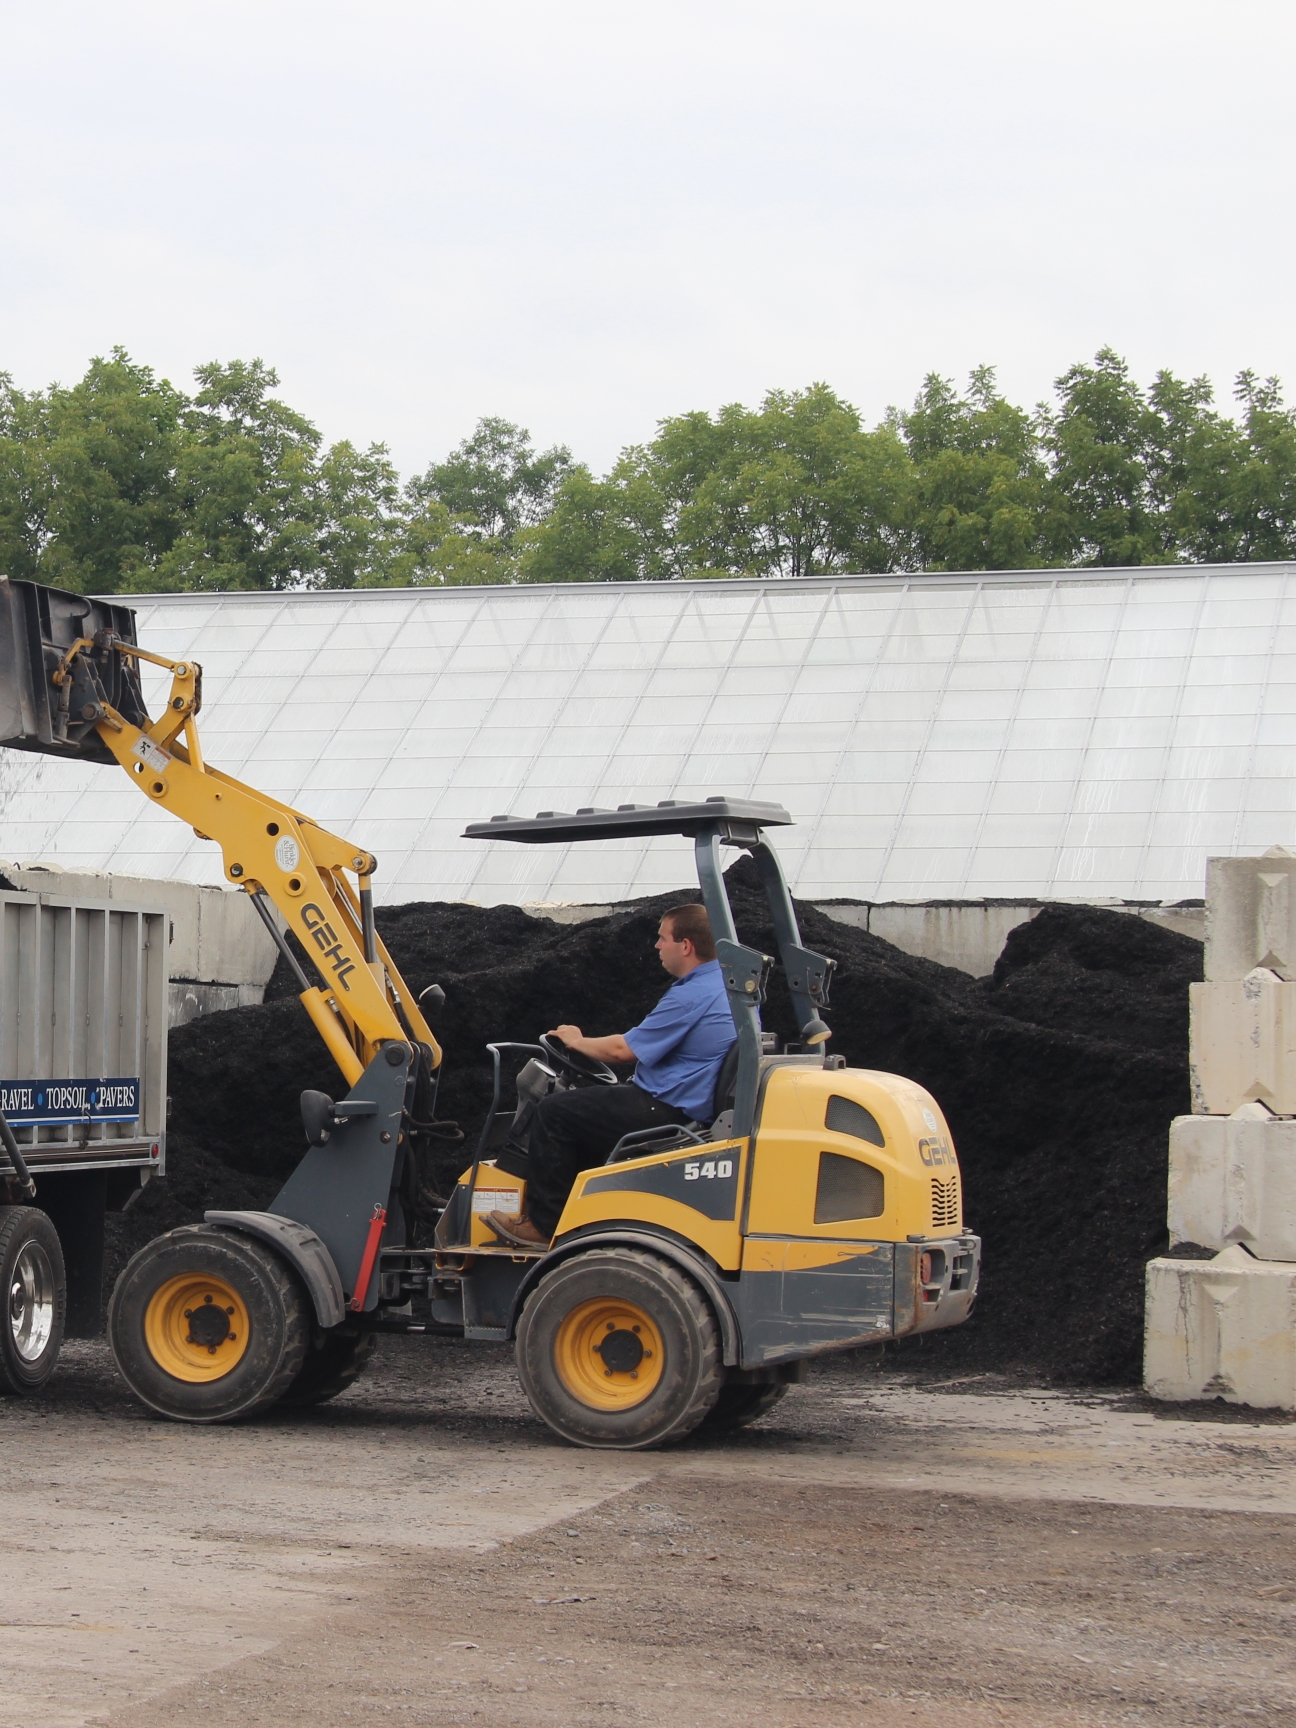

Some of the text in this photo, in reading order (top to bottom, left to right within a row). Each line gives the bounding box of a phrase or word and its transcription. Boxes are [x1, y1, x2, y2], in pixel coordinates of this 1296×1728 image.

[301, 903, 355, 991] GEHL
[46, 1087, 90, 1110] TOPSOIL
[100, 1086, 135, 1108] PAVERS
[918, 1136, 957, 1167] GEHL
[684, 1160, 733, 1180] 540
